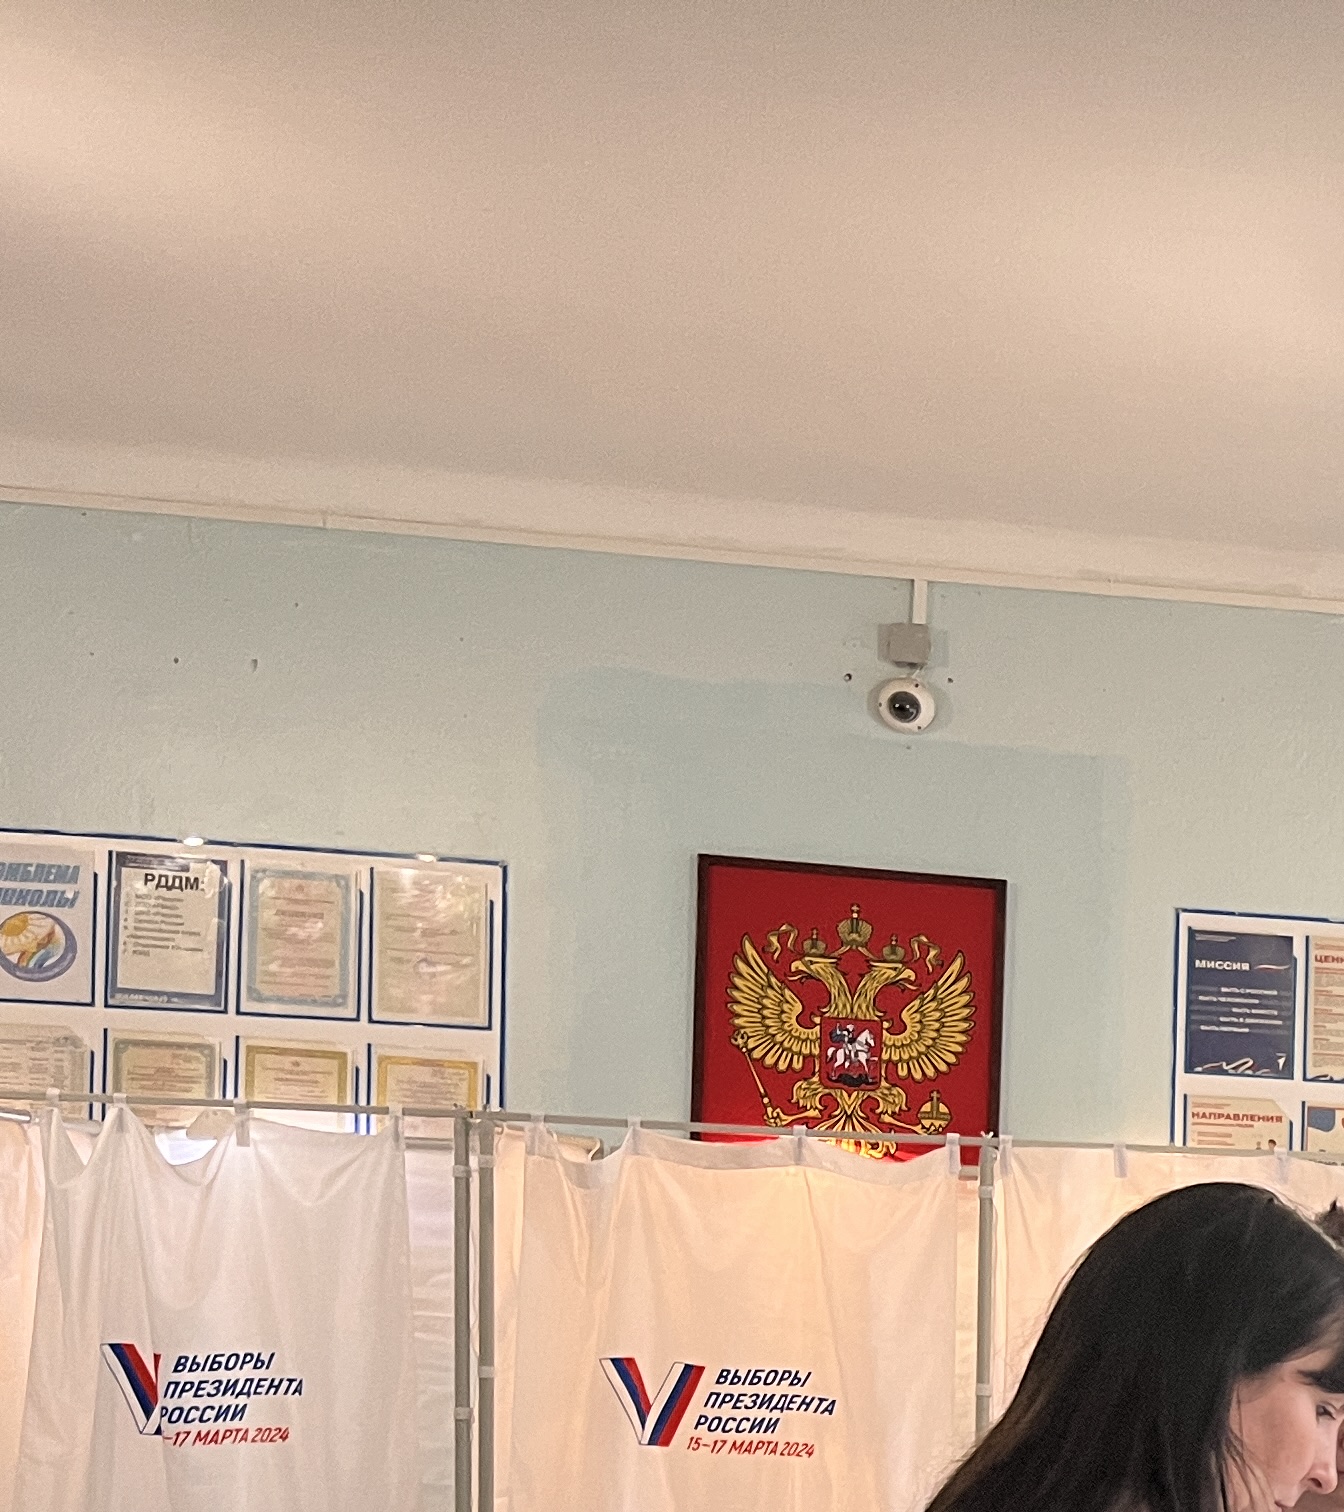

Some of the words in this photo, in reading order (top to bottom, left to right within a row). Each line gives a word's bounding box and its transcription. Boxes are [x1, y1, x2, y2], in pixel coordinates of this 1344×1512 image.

[1194, 959, 1251, 972] МИССИЯ
[1191, 1110, 1284, 1125] НАПРАВЛЕНИЯ
[172, 1351, 276, 1374] ВЫБОРЫ
[714, 1368, 813, 1388] ВЫБОРЫ
[163, 1377, 304, 1400] ПРЕЗИДЕНТА
[703, 1391, 837, 1416] ПРЕЗИДЕНТА
[160, 1403, 248, 1425] РОССИИ
[693, 1414, 781, 1434] РОССИИ
[192, 1427, 250, 1447] МАРТА
[250, 1426, 290, 1444] 2024
[729, 1440, 780, 1457] МАРТА
[778, 1440, 816, 1459] 2024
